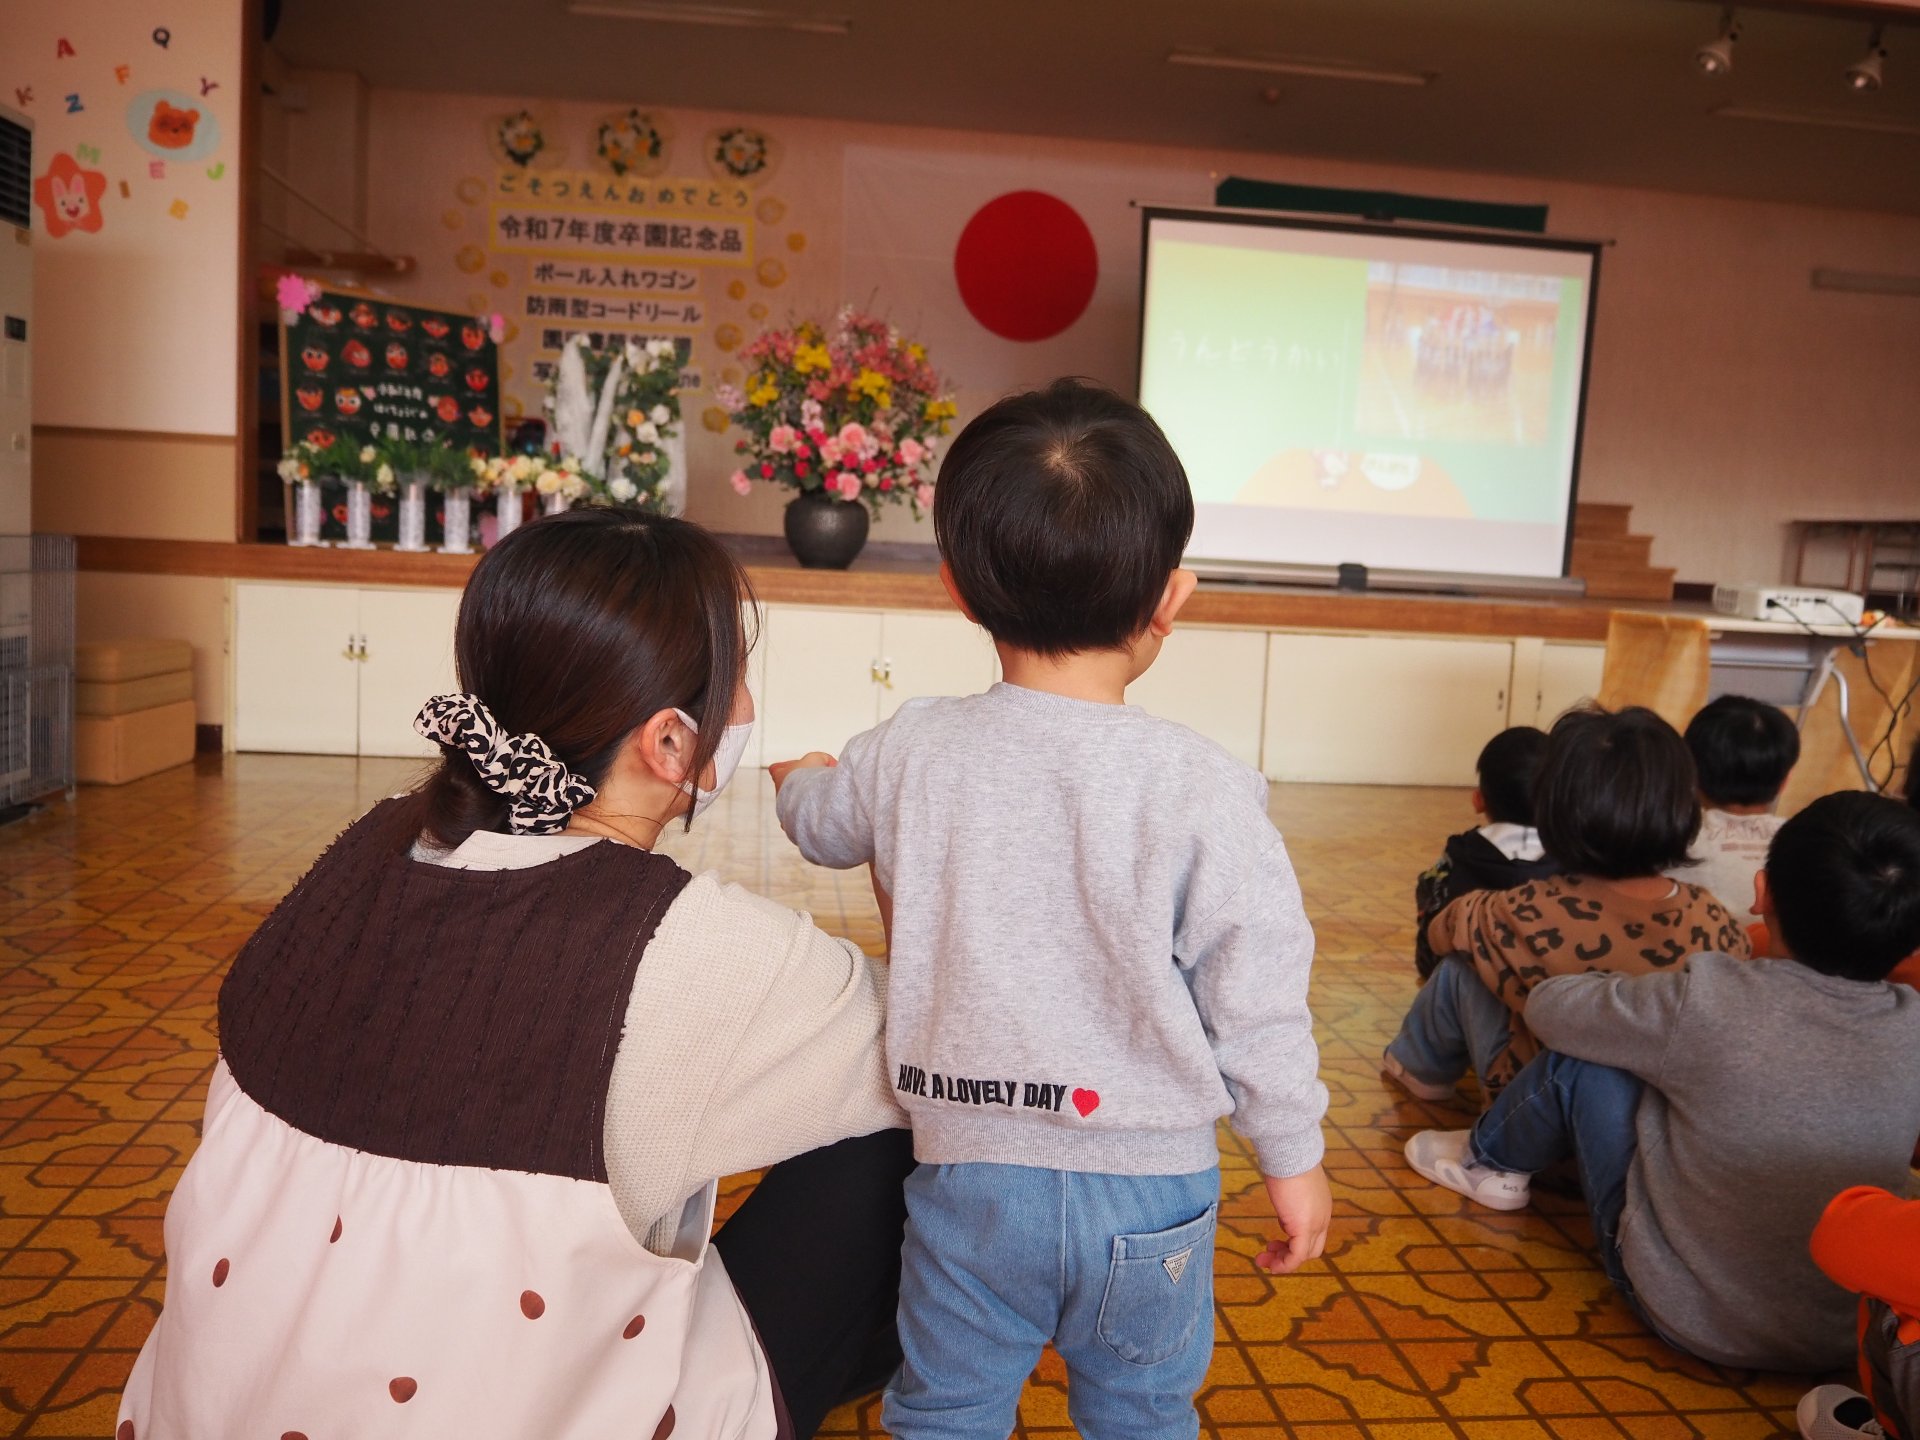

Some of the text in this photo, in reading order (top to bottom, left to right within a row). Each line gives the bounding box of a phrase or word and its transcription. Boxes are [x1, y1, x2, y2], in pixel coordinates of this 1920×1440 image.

[57, 38, 76, 58] A
[152, 27, 171, 49] Q
[114, 64, 130, 85] F
[15, 86, 34, 106] K
[201, 77, 219, 97] Y
[65, 93, 84, 114] Z
[206, 162, 226, 181] J
[500, 214, 743, 253] 令和7年度卒園記念品
[526, 296, 701, 323] 防雨型コードリール
[897, 1064, 1068, 1112] HAVE A LOVELY DAY
